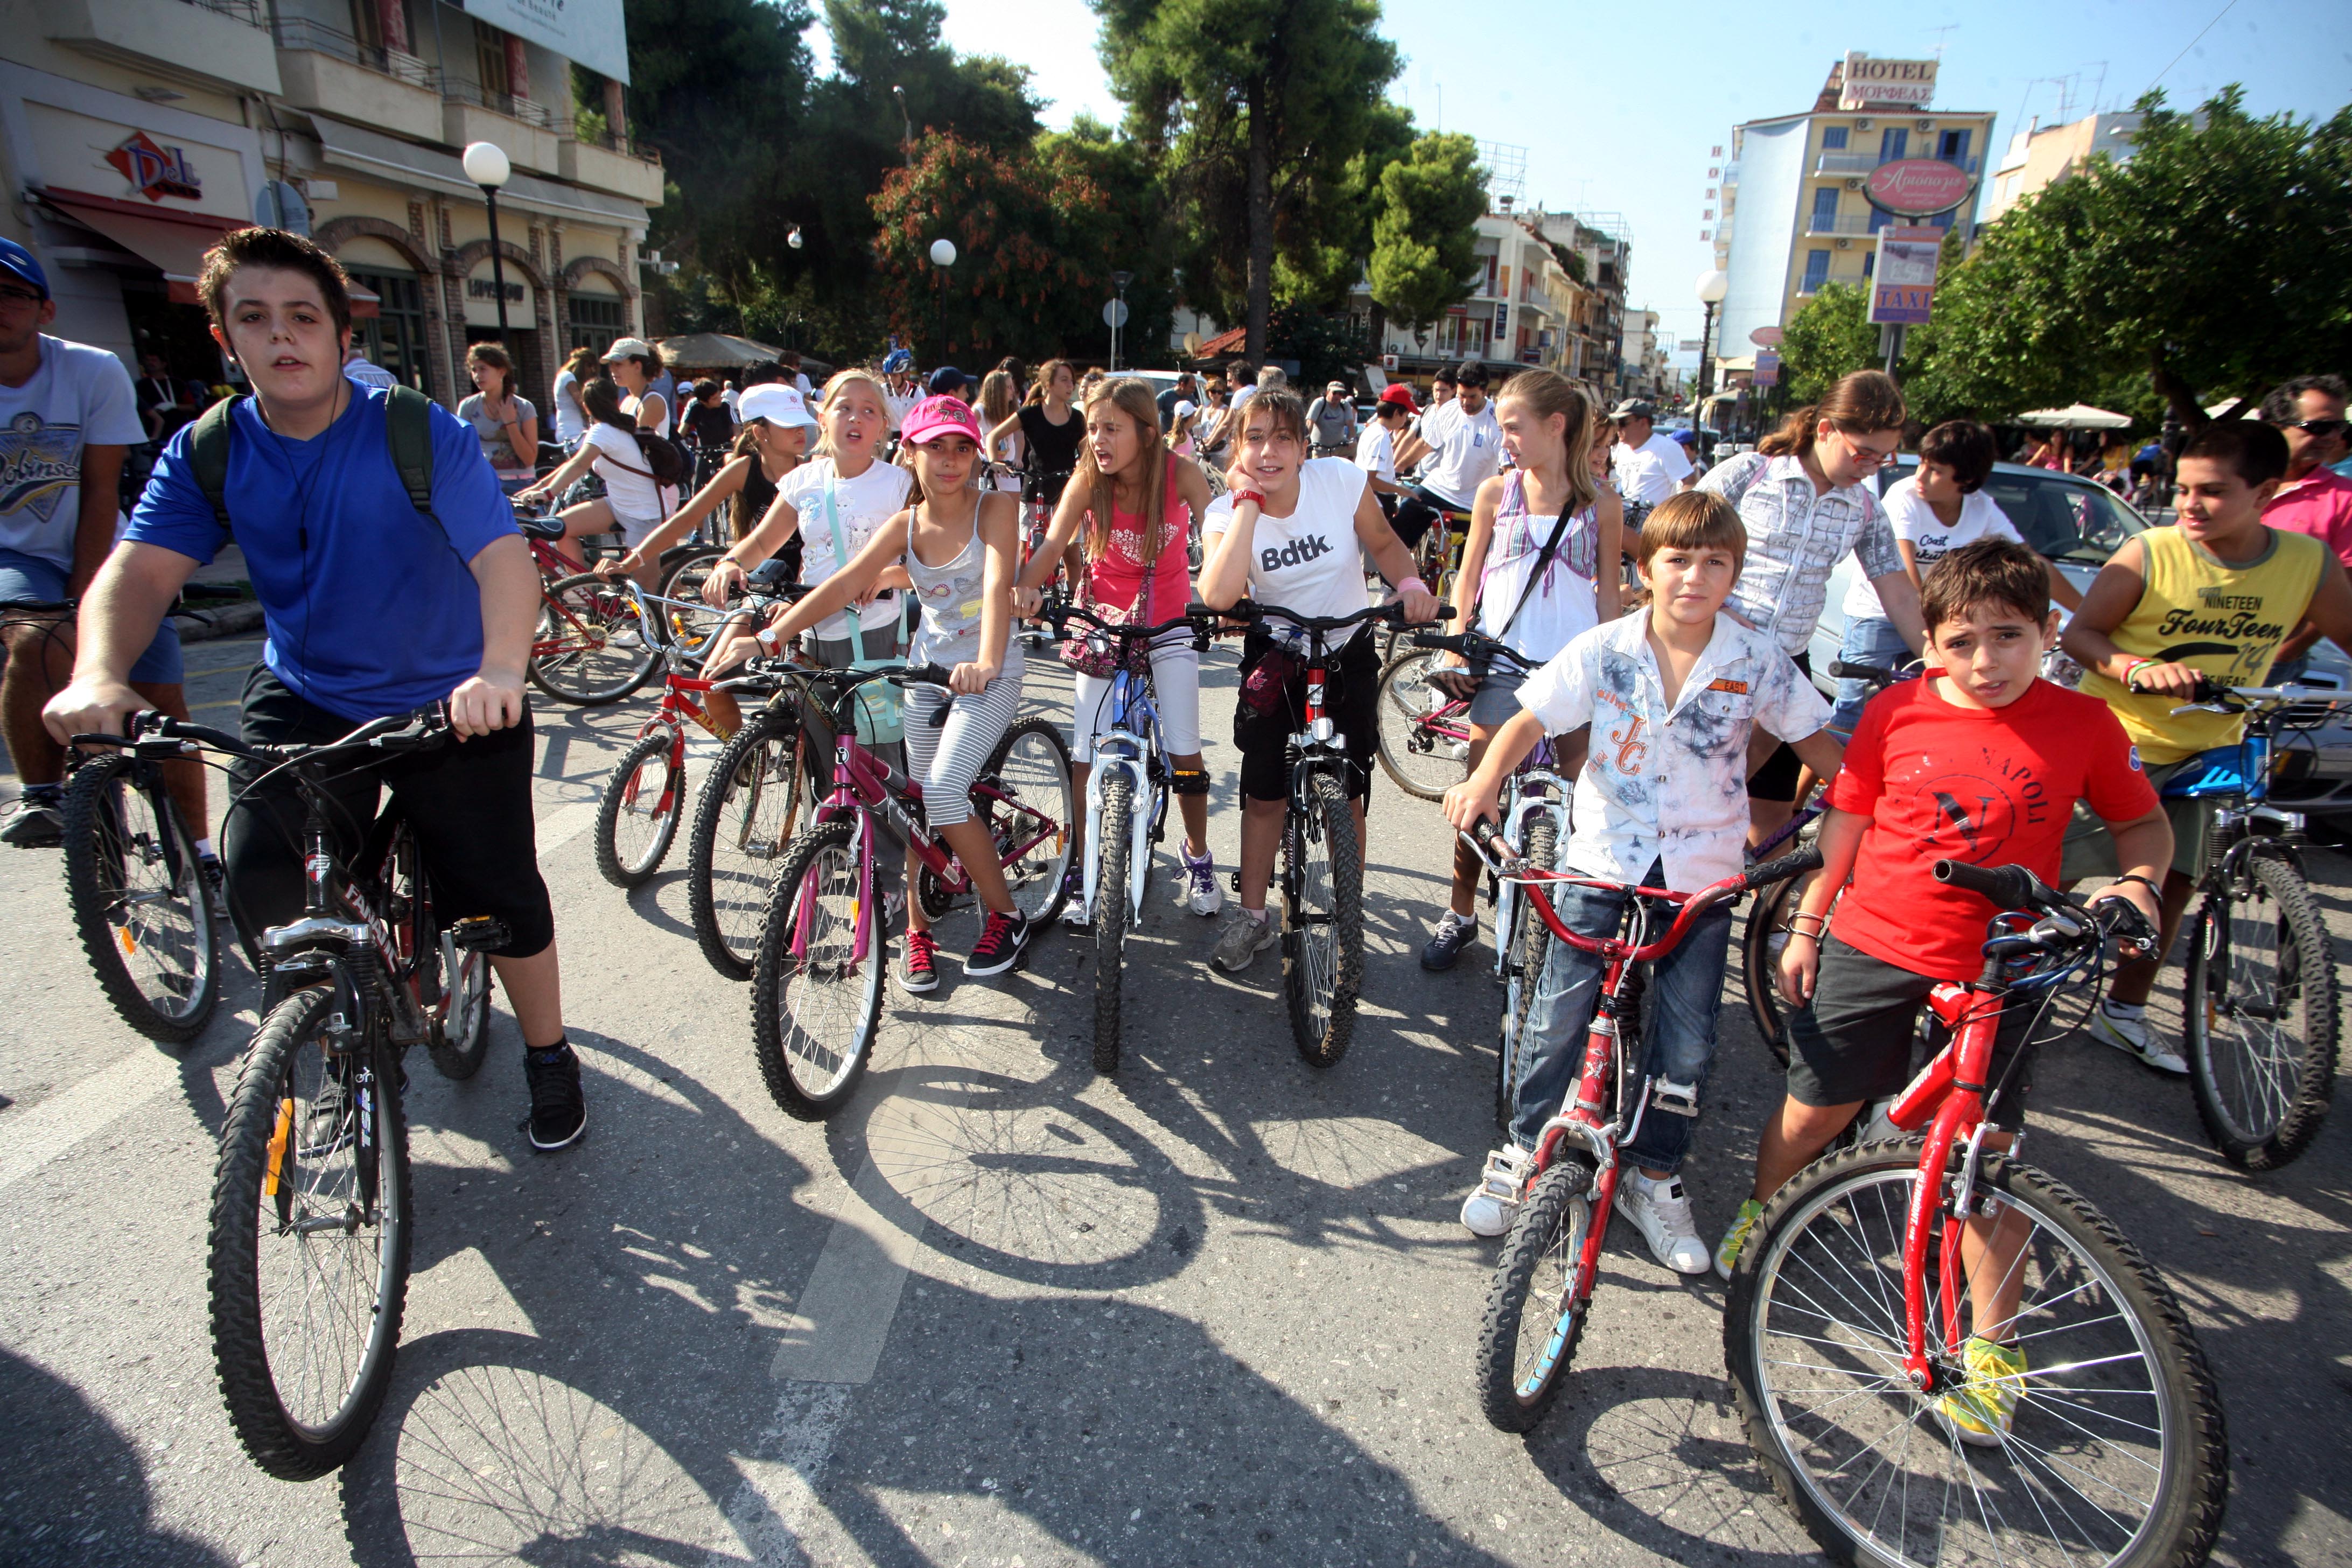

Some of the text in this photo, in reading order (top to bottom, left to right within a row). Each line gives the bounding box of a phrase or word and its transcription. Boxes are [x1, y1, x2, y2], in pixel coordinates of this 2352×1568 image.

[1852, 62, 1933, 80] HOTEL
[1851, 85, 1934, 101] ΜΟΡΦΕΑΣ
[1700, 145, 1723, 241] HOTEL
[1879, 290, 1931, 309] TAXI
[938, 408, 967, 424] 78
[1919, 534, 1949, 547] Coast
[2204, 595, 2263, 611] NINETEEN
[2158, 608, 2284, 647] FourTeen
[2229, 642, 2271, 677] 14
[1724, 681, 1745, 692] EAST
[1976, 746, 2048, 824] NAPOLI
[1921, 791, 1996, 852] N
